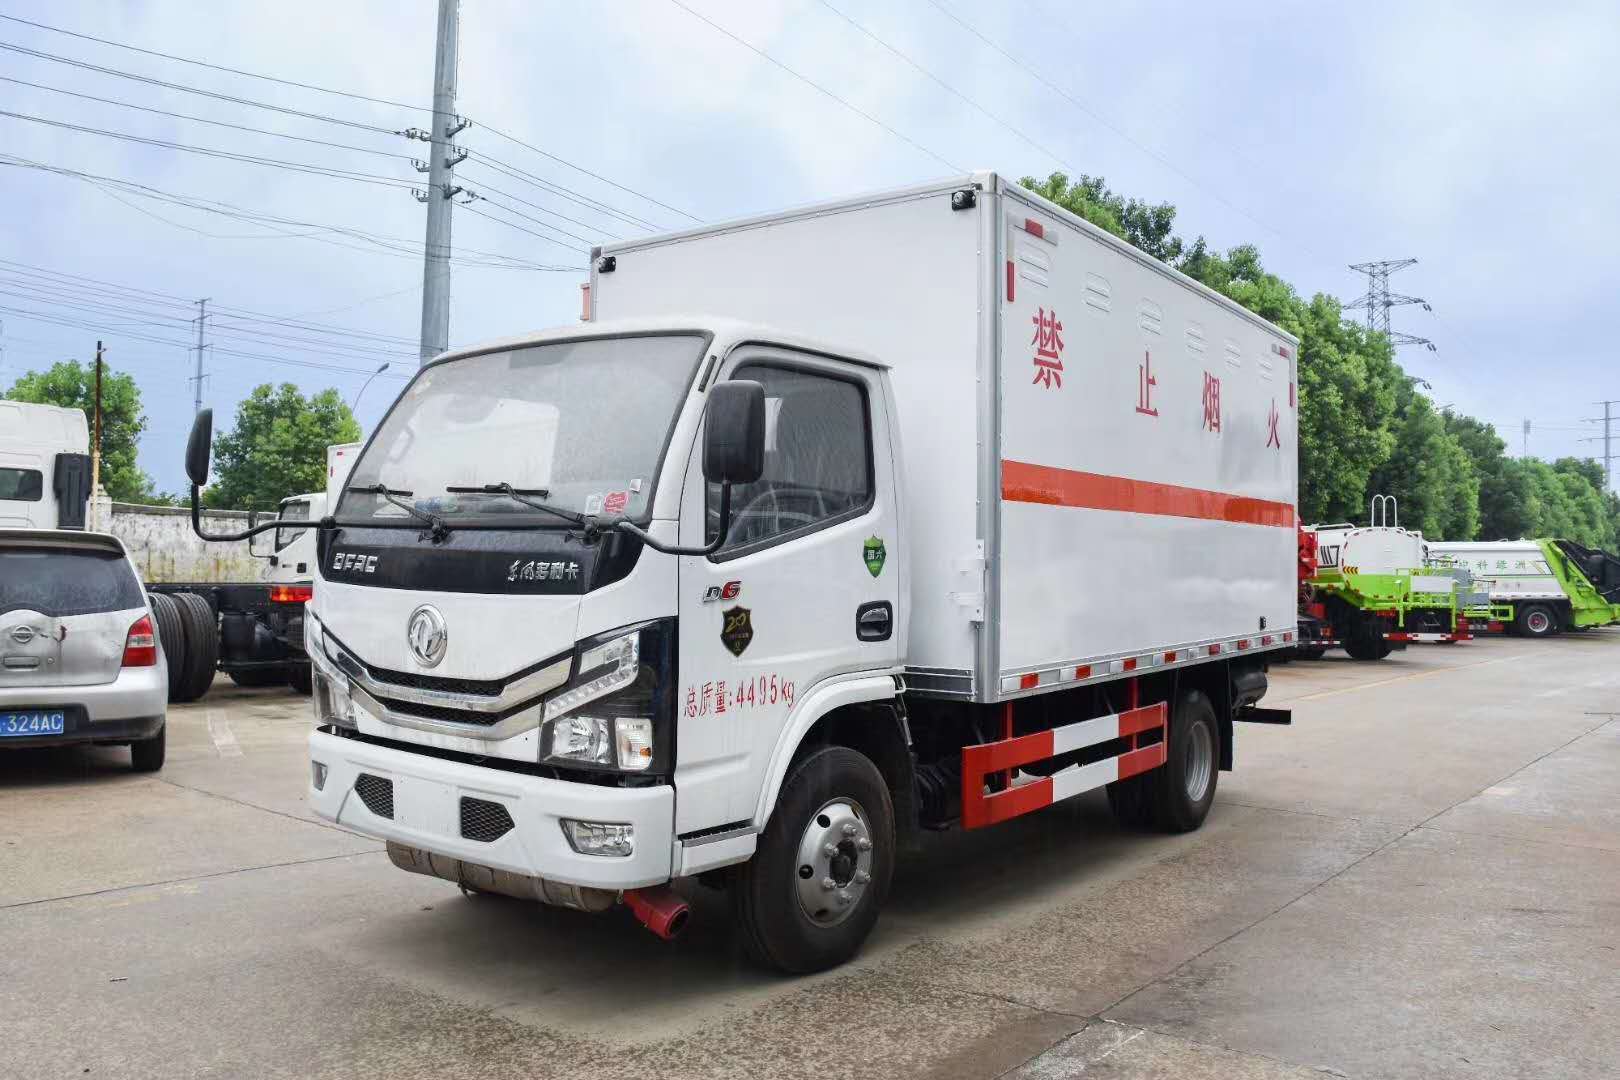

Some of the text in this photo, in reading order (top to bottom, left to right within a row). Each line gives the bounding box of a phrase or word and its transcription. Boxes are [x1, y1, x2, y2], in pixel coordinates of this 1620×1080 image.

[1031, 306, 1281, 450] 禁止烟火
[333, 552, 378, 573] DFAC
[867, 549, 883, 560] 国六
